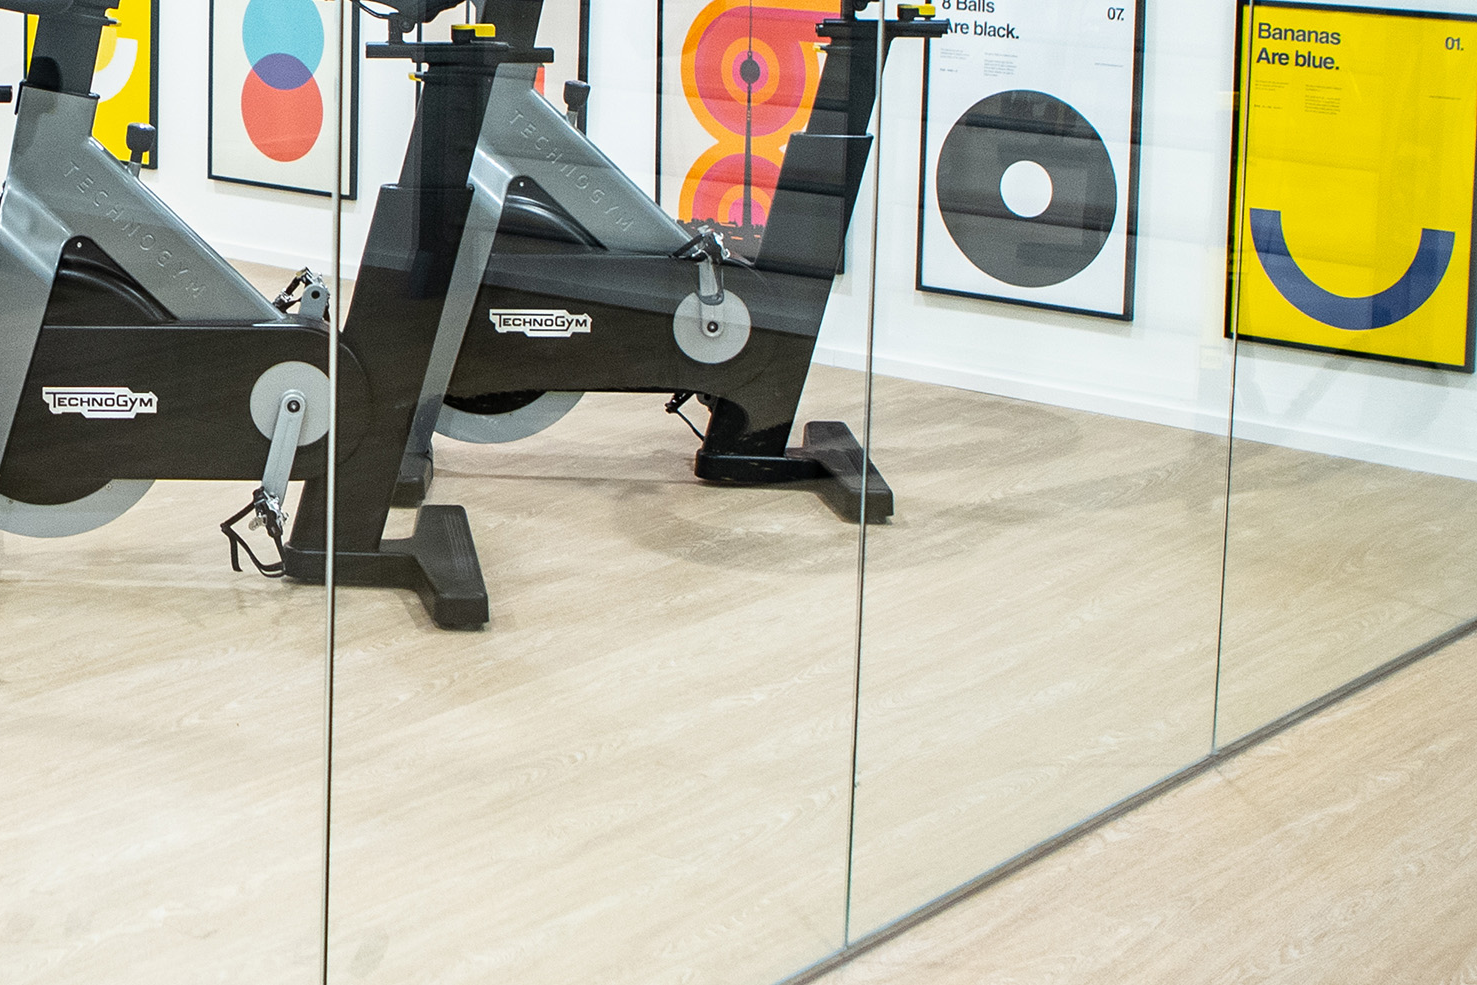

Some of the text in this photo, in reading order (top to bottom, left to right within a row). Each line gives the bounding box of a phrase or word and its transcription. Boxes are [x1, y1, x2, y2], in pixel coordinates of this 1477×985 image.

[1107, 6, 1125, 22] 07.
[973, 20, 1020, 39] black.
[1257, 21, 1342, 46] Bananas
[1444, 36, 1465, 51] 01.
[1255, 47, 1341, 71] Are blue.
